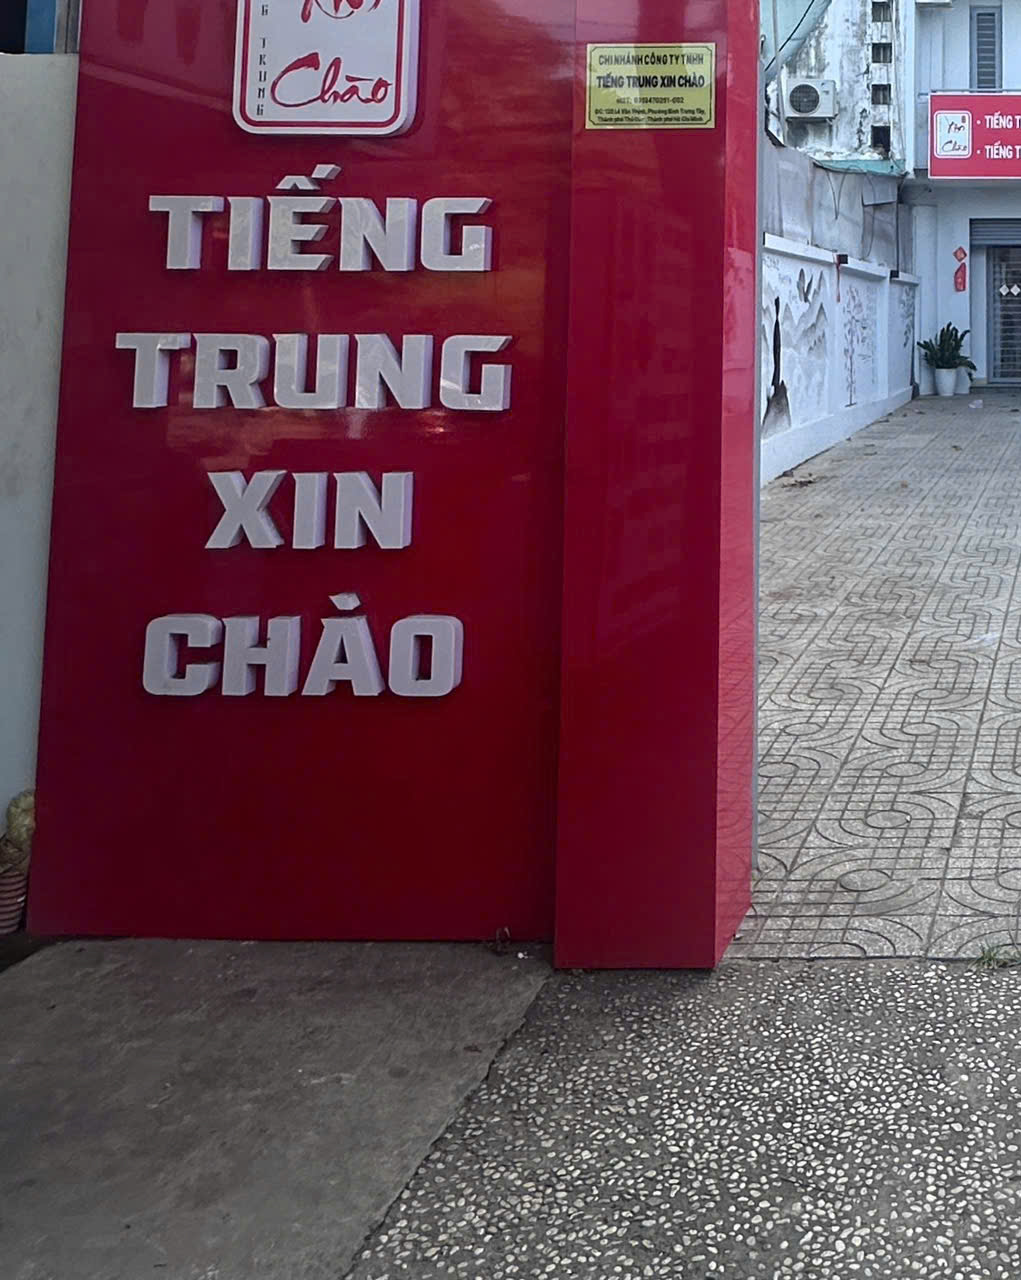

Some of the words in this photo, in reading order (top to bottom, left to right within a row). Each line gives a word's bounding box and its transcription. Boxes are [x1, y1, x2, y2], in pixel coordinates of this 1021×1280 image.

[596, 72, 625, 88] TIẾNG
[626, 75, 658, 88] TRUNG
[660, 75, 676, 88] XIN
[678, 72, 705, 88] CHÀO
[669, 54, 679, 65] TY
[985, 111, 1013, 128] TIẾNG
[985, 141, 1013, 159] TIẾNG
[149, 164, 493, 271] TIẾNG
[115, 332, 513, 411] TRUNG
[205, 470, 414, 549] XIN
[142, 592, 464, 697] CHÀO
